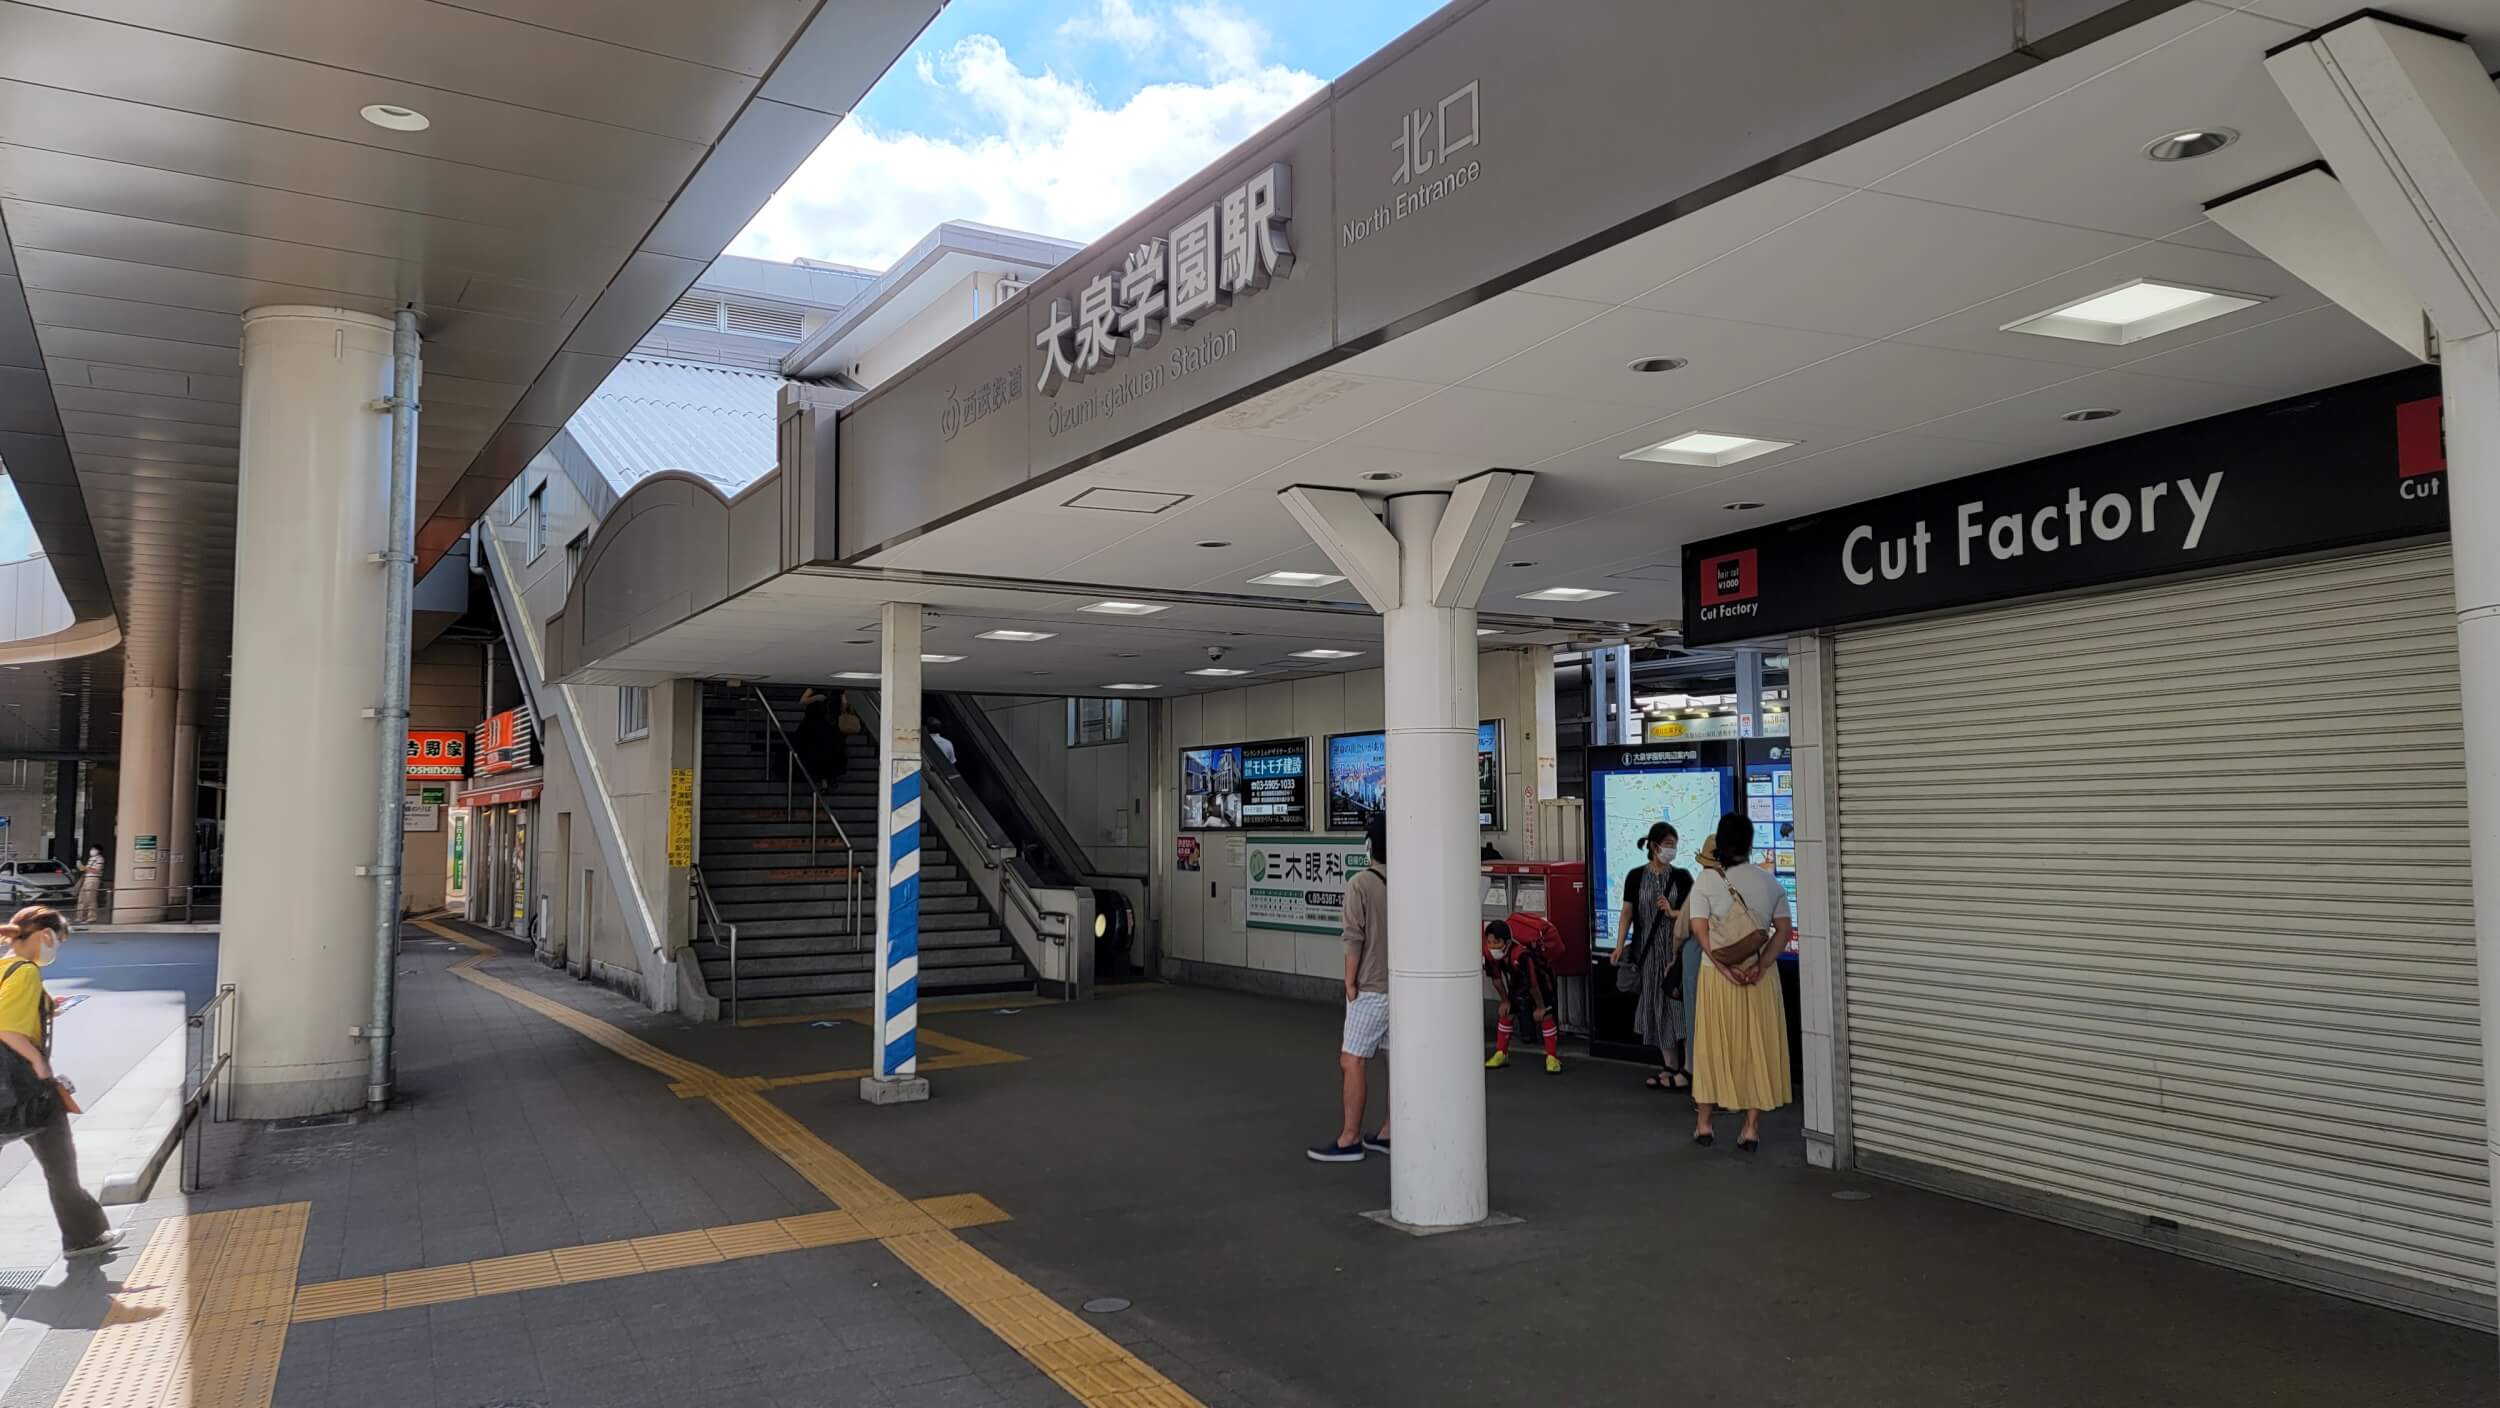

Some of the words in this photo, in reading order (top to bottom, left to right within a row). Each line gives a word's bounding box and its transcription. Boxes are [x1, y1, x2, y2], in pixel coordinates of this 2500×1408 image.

[1391, 79, 1480, 186] 北口
[1343, 204, 1391, 248] North
[1396, 160, 1481, 220] Entrance
[1036, 163, 1292, 396] 大泉学園駅
[1169, 327, 1238, 380] Station
[963, 364, 1023, 428] 西武鉄道
[2400, 478, 2440, 500] Cut
[1841, 520, 1932, 586] Cut
[1957, 471, 2225, 567] Factory
[1700, 607, 1717, 621] Cut
[1719, 602, 1759, 618] Factory
[1252, 757, 1303, 775] モトモチ建設
[1267, 850, 1344, 885] 三木眼科
